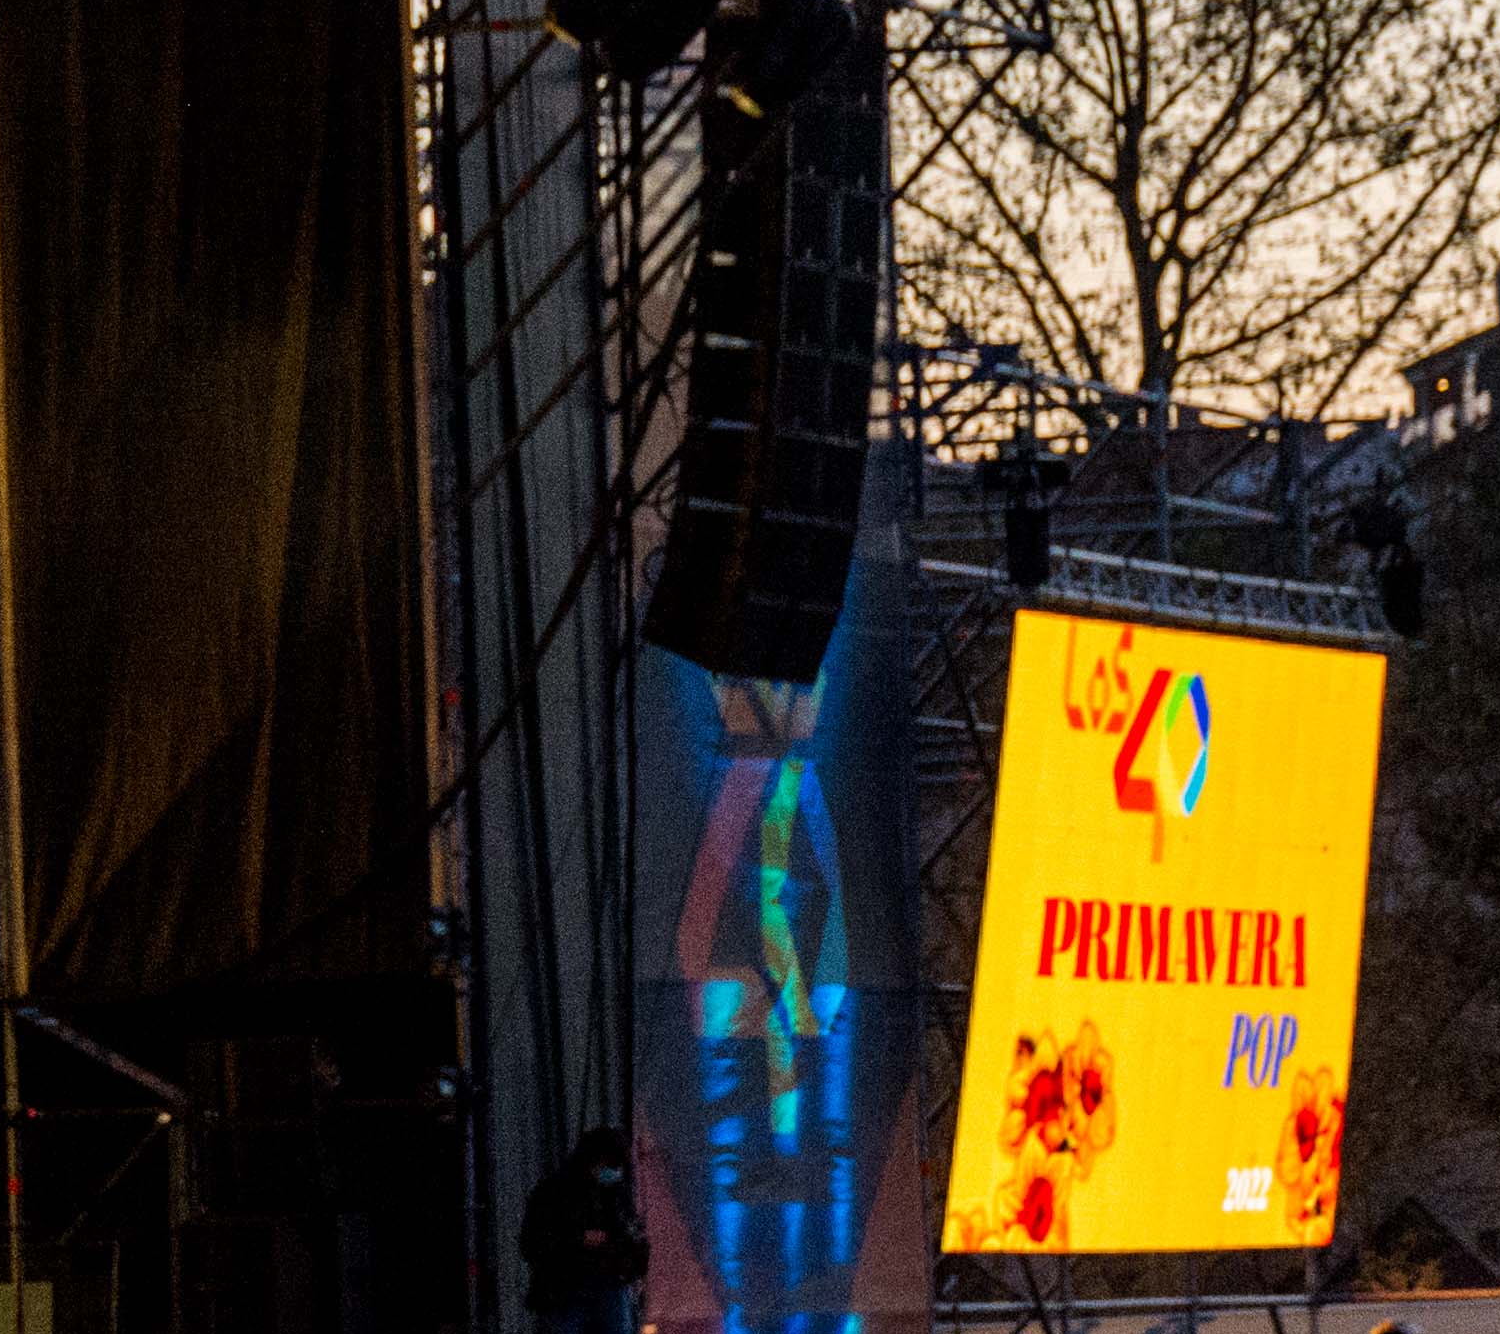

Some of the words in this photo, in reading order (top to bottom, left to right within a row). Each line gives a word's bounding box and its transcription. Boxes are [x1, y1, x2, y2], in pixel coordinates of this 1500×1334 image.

[1114, 667, 1211, 864] 40
[1036, 895, 1307, 989] PRIMAVERA
[1221, 1012, 1298, 1089] POP
[1221, 1166, 1274, 1213] 2022
